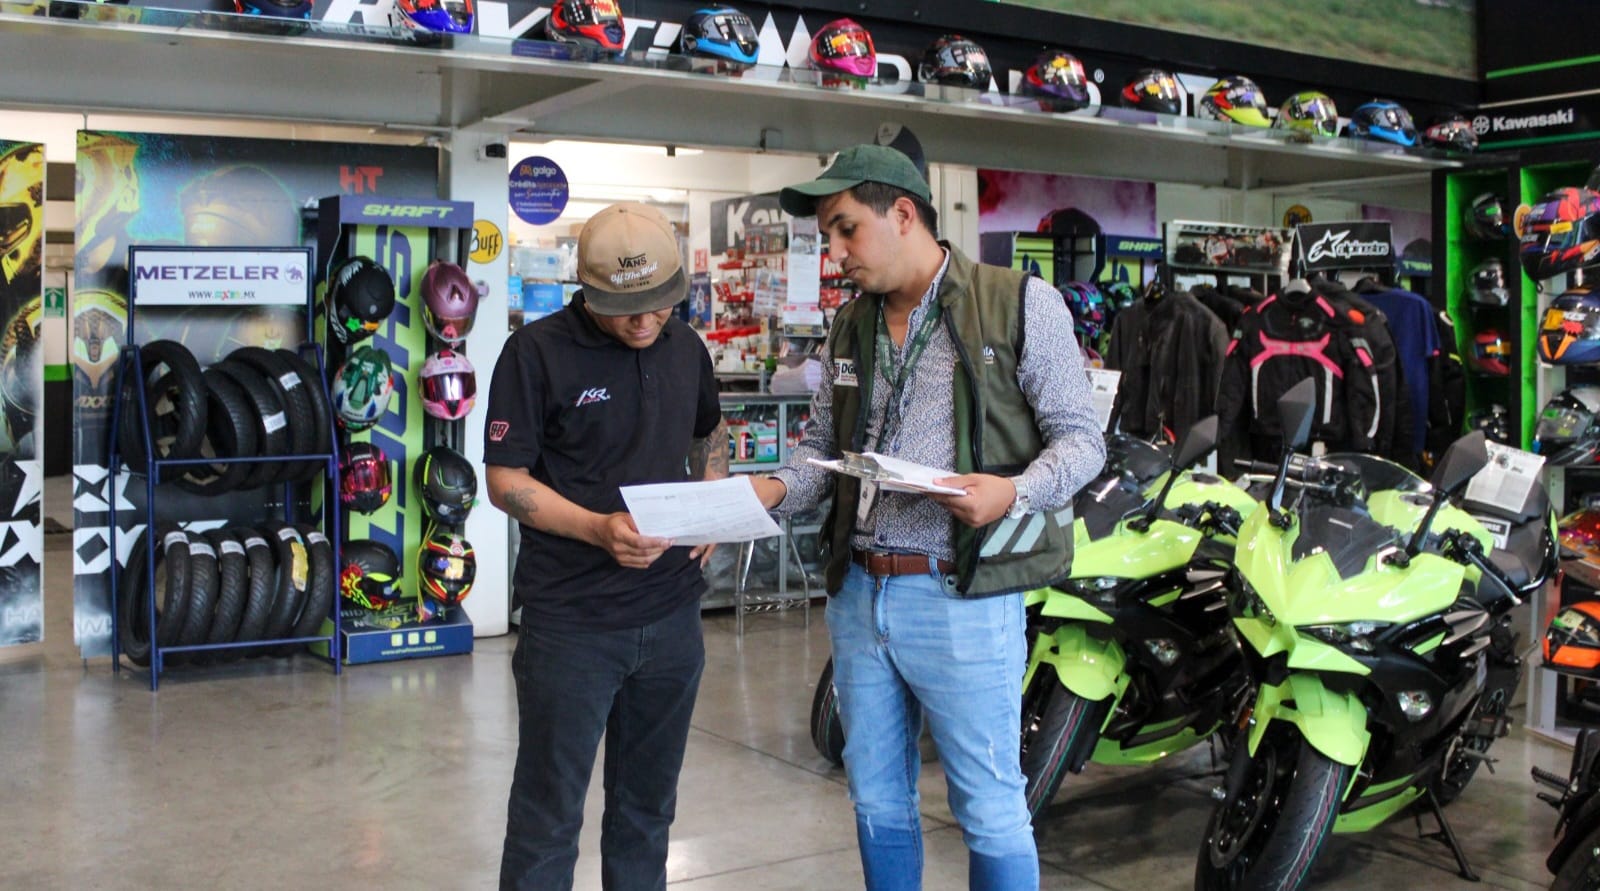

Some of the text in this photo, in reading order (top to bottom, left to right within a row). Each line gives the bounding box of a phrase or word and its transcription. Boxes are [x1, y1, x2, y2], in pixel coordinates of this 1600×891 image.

[1493, 109, 1573, 132] Kawasaki
[339, 165, 384, 193] HT
[362, 204, 454, 218] SHAFT
[617, 253, 647, 268] VANS
[136, 266, 279, 280] METZELER
